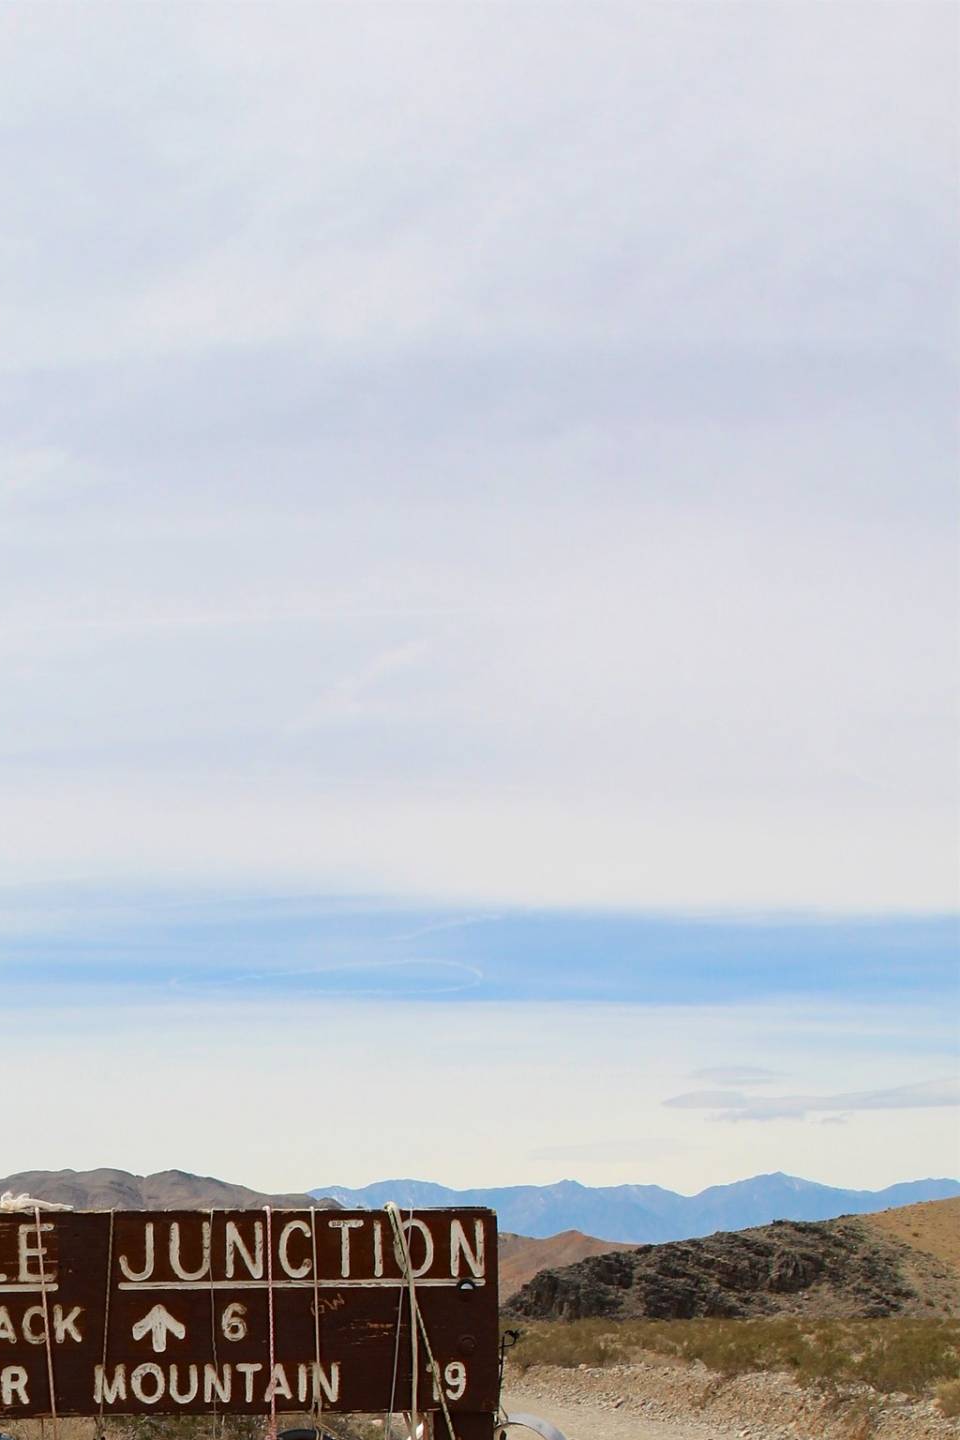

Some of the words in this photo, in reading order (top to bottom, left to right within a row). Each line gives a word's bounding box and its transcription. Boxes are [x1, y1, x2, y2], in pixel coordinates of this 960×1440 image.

[119, 1218, 486, 1281] JUNCTION
[221, 1303, 248, 1342] 6
[93, 1362, 340, 1404] MOUNTAIN
